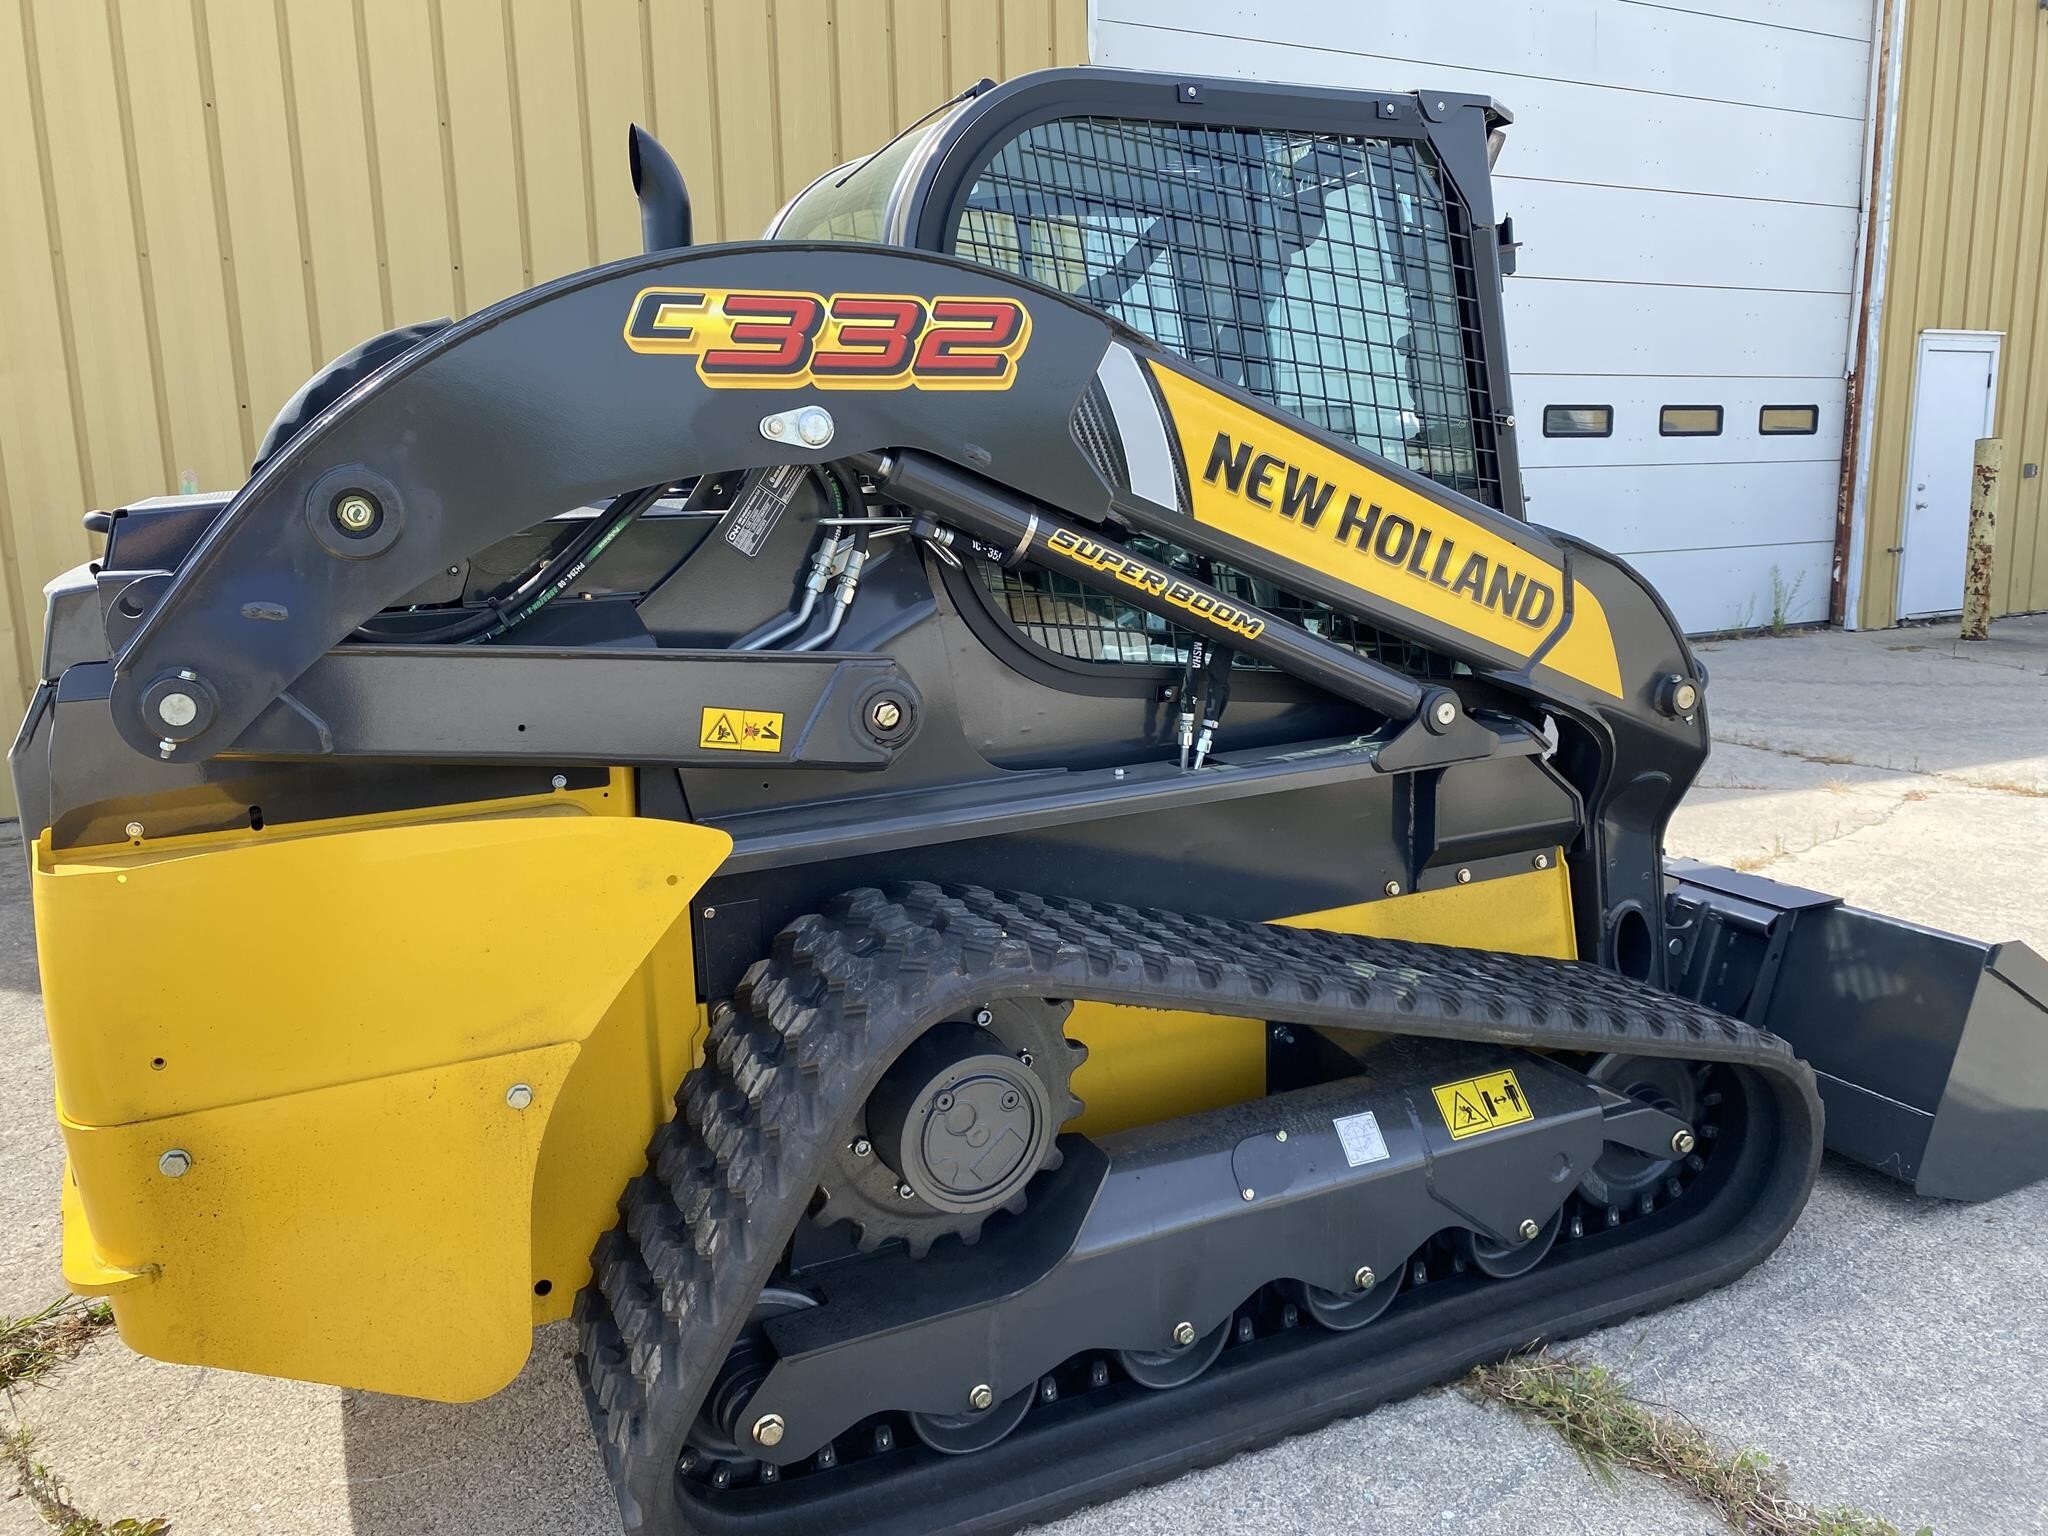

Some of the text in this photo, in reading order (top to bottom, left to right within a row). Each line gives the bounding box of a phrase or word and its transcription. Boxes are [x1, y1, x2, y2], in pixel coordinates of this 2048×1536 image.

[625, 289, 1030, 386] C332
[728, 524, 741, 541] CNH
[1202, 430, 1555, 629] NEW HOLLAND
[1048, 528, 1265, 640] SUPER BOOM
[1192, 641, 1203, 669] MSHA
